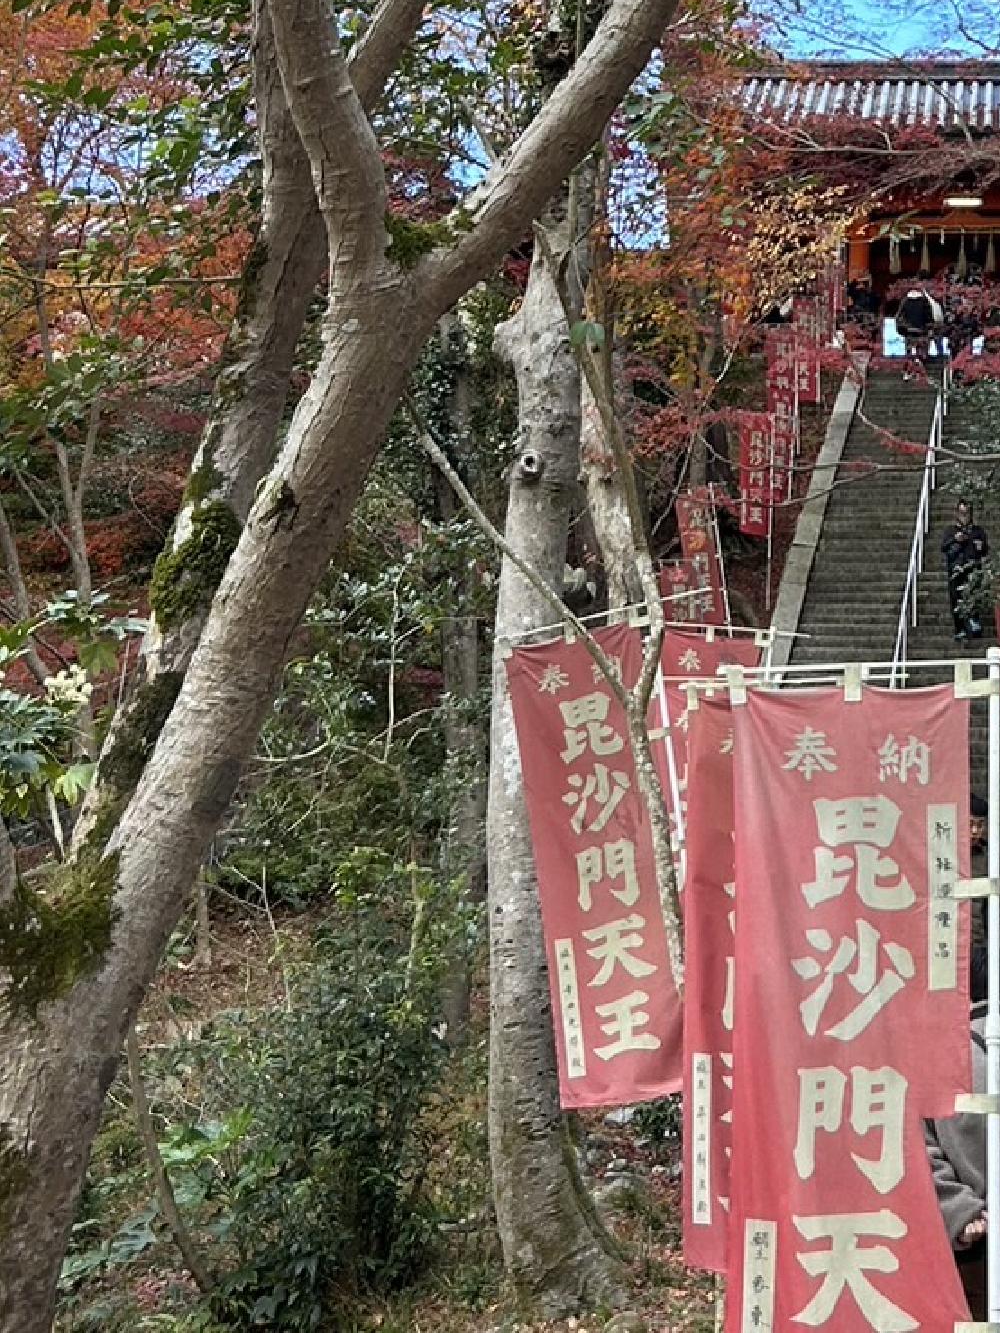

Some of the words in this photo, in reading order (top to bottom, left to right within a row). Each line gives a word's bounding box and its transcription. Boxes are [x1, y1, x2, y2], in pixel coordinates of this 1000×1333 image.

[559, 691, 662, 1061] 毘沙門天王
[780, 725, 932, 785] 奉納
[789, 794, 922, 1332] 毘沙門天
